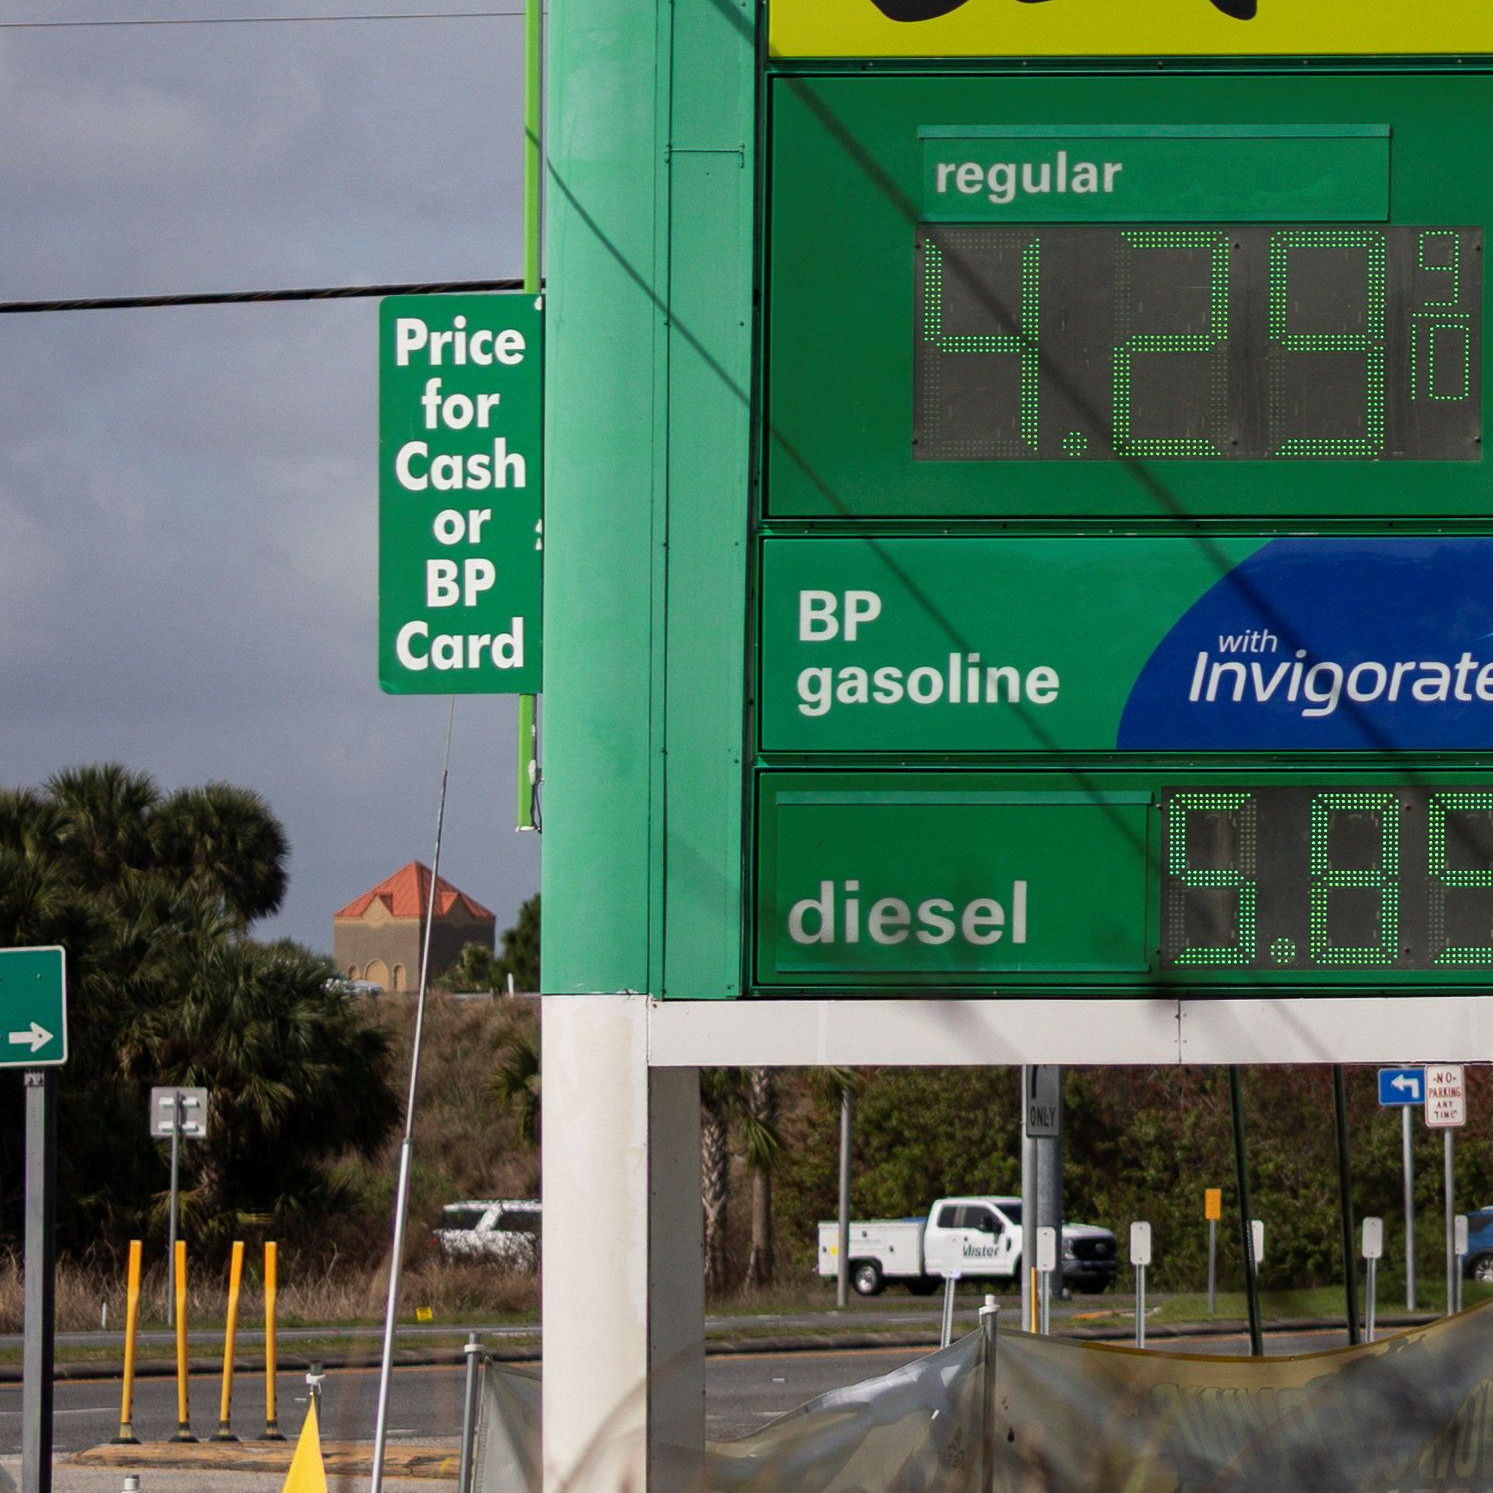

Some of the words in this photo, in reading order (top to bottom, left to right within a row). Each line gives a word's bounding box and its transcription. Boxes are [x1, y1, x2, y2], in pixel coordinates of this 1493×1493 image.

[934, 151, 1123, 204] regular
[395, 315, 526, 366] Price
[922, 230, 1386, 456] 4.29
[421, 378, 500, 429] for
[395, 437, 526, 491] Cash
[433, 508, 491, 546] or
[426, 558, 496, 607] BP
[797, 589, 883, 642] BP
[1218, 626, 1278, 653] with
[395, 617, 525, 671] Card
[796, 652, 1061, 717] gasoline
[788, 880, 1028, 946] diesel
[1429, 1087, 1461, 1098] PARKING
[1436, 1071, 1453, 1083] NO
[1030, 1106, 1056, 1126] ONLY
[1437, 1100, 1453, 1109] ANY
